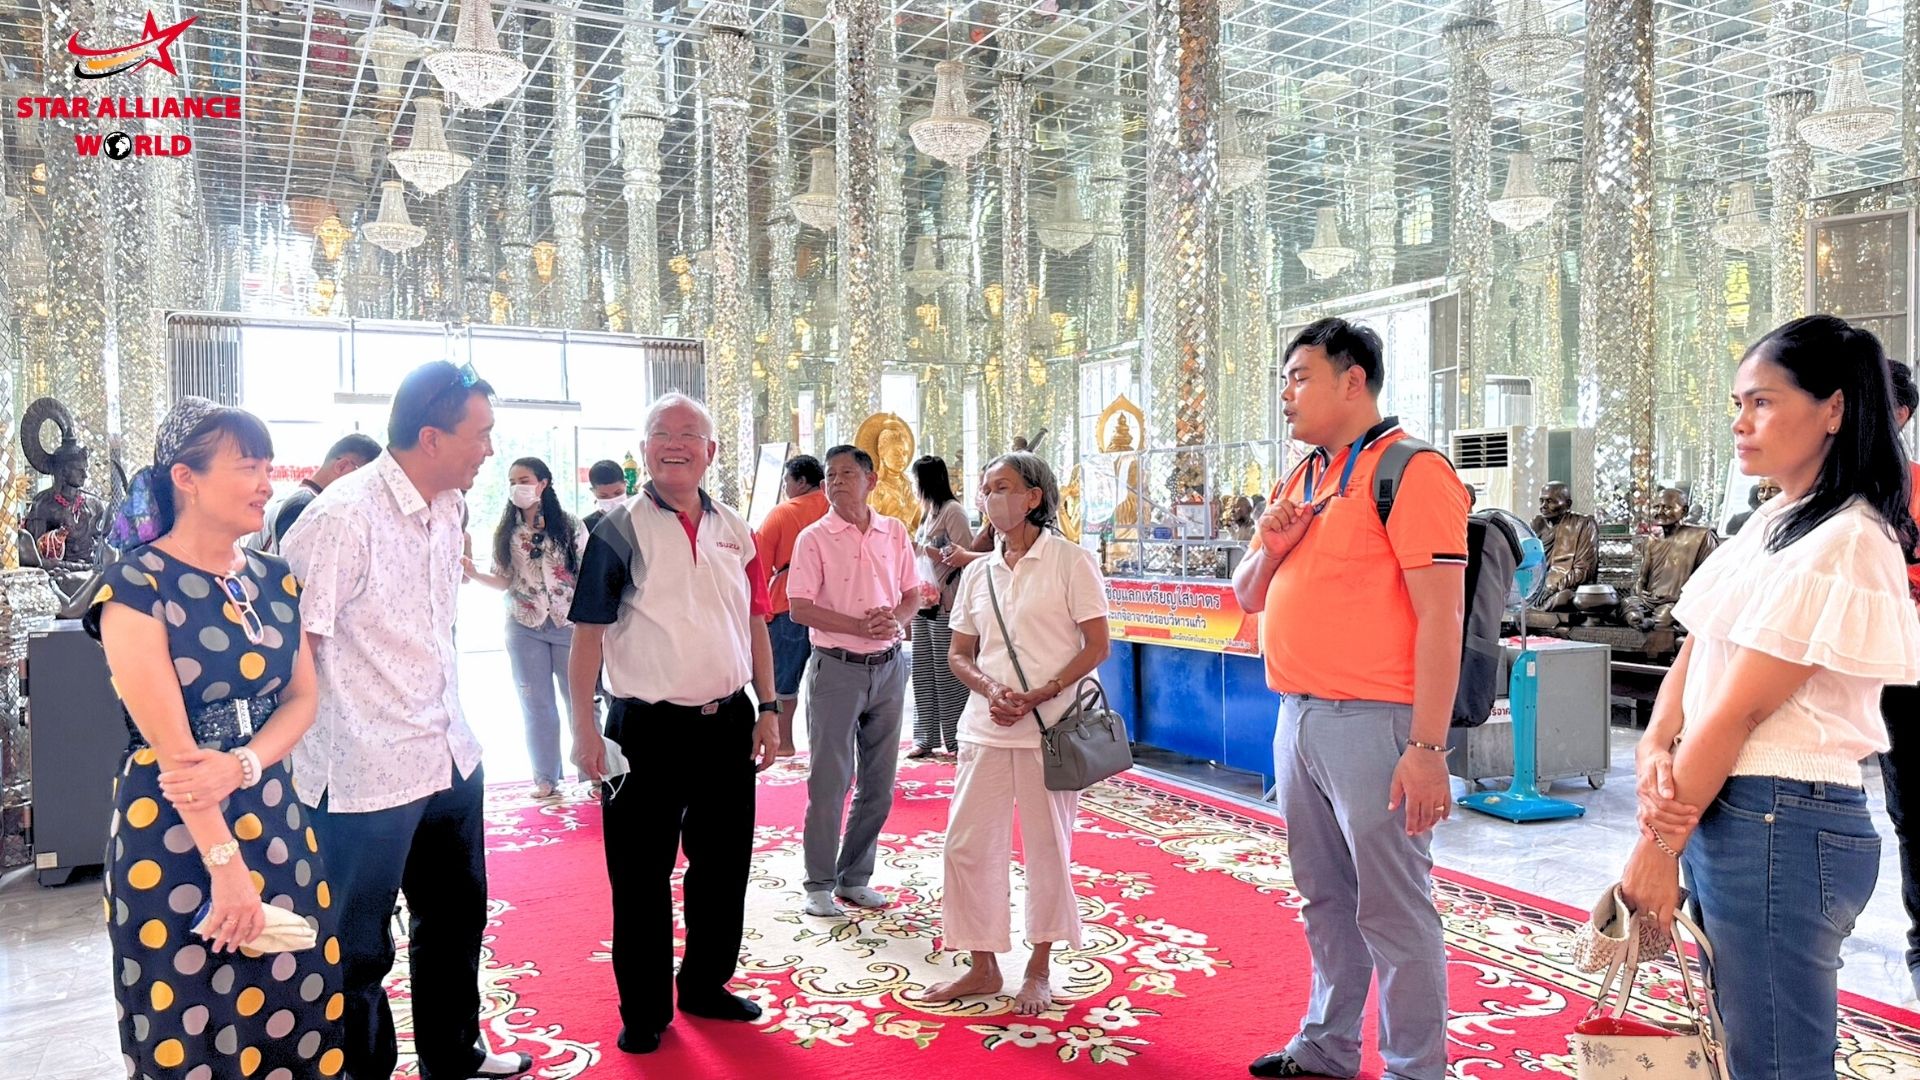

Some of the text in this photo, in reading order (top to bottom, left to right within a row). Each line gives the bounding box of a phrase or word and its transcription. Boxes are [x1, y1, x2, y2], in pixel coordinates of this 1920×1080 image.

[716, 541, 740, 550] ISUZU
[1105, 583, 1220, 609] ชิญแลกเหรียญใส่บาตร
[1491, 706, 1511, 716] ริจาค
